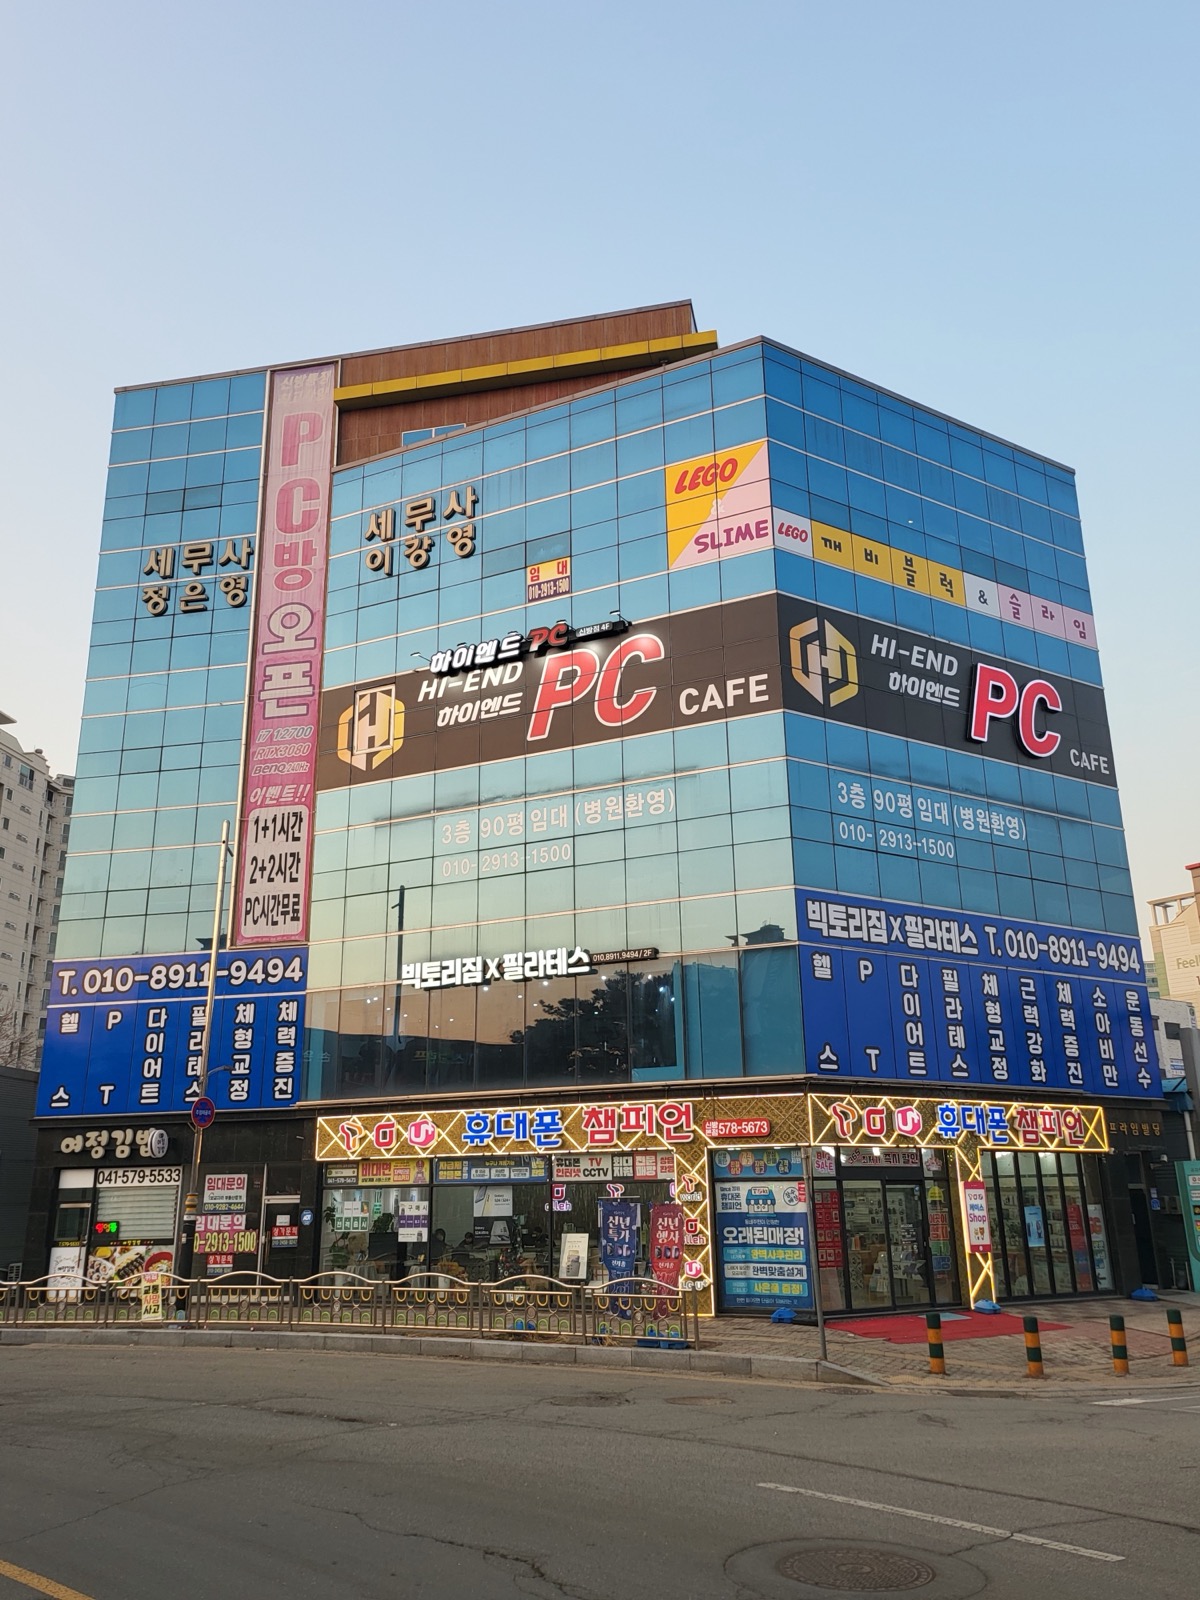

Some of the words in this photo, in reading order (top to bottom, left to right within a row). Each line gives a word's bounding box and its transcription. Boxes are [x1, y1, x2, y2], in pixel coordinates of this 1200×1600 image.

[674, 458, 738, 494] LEGO
[365, 485, 479, 542] 세무사
[710, 498, 726, 515] &
[365, 523, 476, 577] 이강영
[694, 519, 769, 554] SLIME
[143, 536, 255, 579] 세무사
[142, 574, 248, 616] 정은영
[528, 577, 570, 600] 010-2913-1500
[777, 521, 809, 544] LEGO
[820, 535, 955, 598] 깨비블럭
[978, 589, 989, 606] &
[1008, 592, 1087, 639] 슬라임
[257, 603, 317, 719] 오픈
[430, 632, 521, 674] 하이엔드
[528, 623, 568, 652] PC
[871, 633, 959, 677] HI-END
[417, 661, 523, 703] HI-END
[526, 633, 665, 742] PC
[679, 673, 769, 716] CAFE
[888, 671, 961, 708] 하이엔드
[437, 691, 523, 727] 하이엔드
[970, 661, 1062, 758] PC
[1069, 749, 1110, 775] CAFE
[254, 743, 311, 760] RTX3080
[273, 725, 313, 742] 12700
[250, 784, 311, 805] 이벤트!!
[837, 782, 867, 809] 3층
[873, 789, 914, 819] 90평
[917, 797, 950, 827] 임대
[953, 804, 1027, 841] (병원환영)
[254, 811, 303, 844] 1+1시간
[441, 819, 471, 845] 3층
[480, 811, 525, 840] 90평
[531, 804, 568, 832] 임대
[574, 788, 676, 827] (병원환영)
[249, 852, 301, 885] 2+2시간
[244, 893, 301, 927] PC시간무료
[900, 964, 927, 1075] 다이어트
[941, 967, 969, 1078] 필라테스
[981, 972, 1008, 1081] 체형교정
[1020, 977, 1047, 1084] 근력강화
[1056, 980, 1084, 1085] 체력증진
[1092, 987, 1119, 1087] 소아비만
[139, 1008, 168, 1104] 다이어트
[229, 1003, 256, 1101] 체형교정
[273, 1000, 298, 1100] 체력증진
[1125, 989, 1152, 1089] 운동선수
[461, 1109, 564, 1149] 휴대폰
[582, 1102, 694, 1146] 챔피언
[718, 1121, 768, 1134] 578-5673
[937, 1102, 1009, 1144] 휴대폰
[1016, 1107, 1086, 1146] 챔피언
[1109, 1121, 1161, 1136] 프라임빌딩
[556, 1157, 581, 1167] 휴대폰
[588, 1157, 602, 1167] TV
[556, 1168, 581, 1178] 인터넷
[583, 1168, 609, 1177] CCTV
[815, 1160, 833, 1171] SALE
[848, 1148, 861, 1165] 365
[884, 1152, 900, 1165] 즉시
[902, 1152, 918, 1164] 할인
[97, 1168, 181, 1185] 041-579-5533
[207, 1177, 246, 1191] 임대문의
[680, 1192, 703, 1202] world
[720, 1193, 741, 1201] 휴대폰
[721, 1201, 742, 1210] 챔피언
[607, 1215, 631, 1229] 신년
[607, 1229, 631, 1243] 특가
[656, 1217, 679, 1231] 신년
[723, 1226, 805, 1245] 오래된매장!
[969, 1213, 987, 1224] Shop
[656, 1230, 680, 1244] 행사
[143, 1304, 160, 1315] 사고
